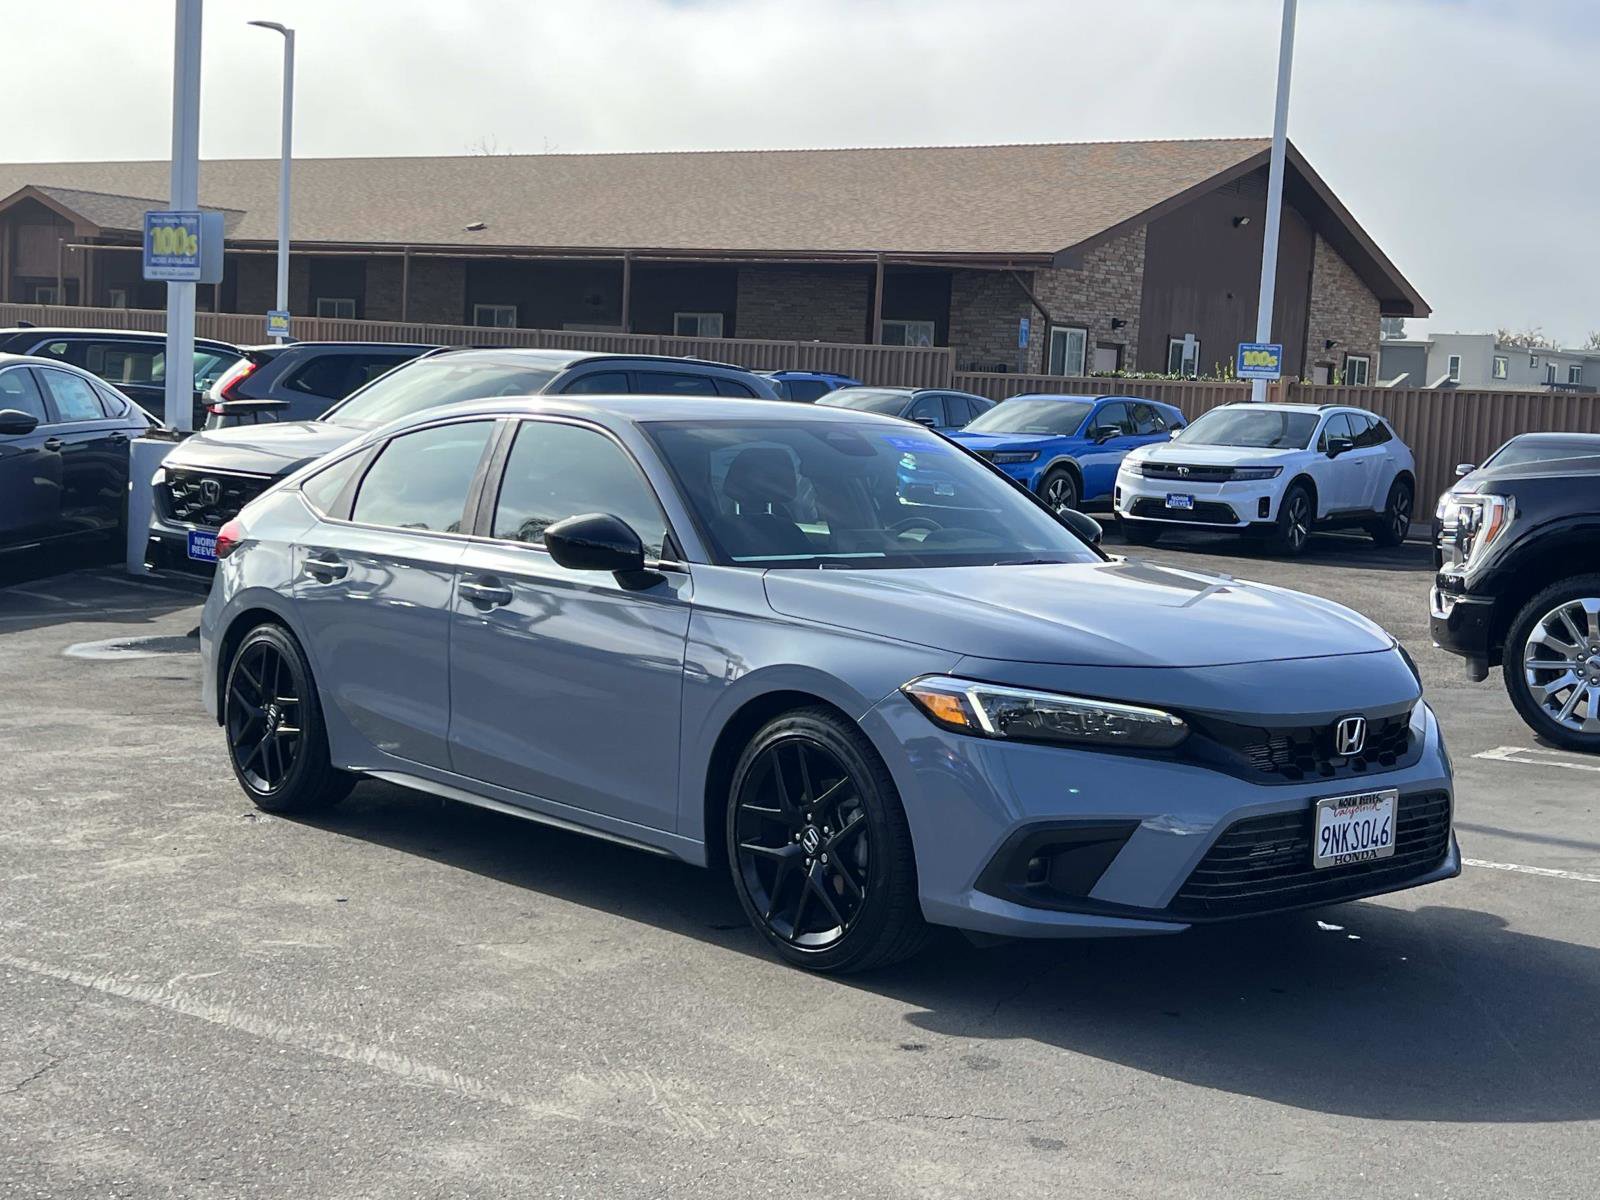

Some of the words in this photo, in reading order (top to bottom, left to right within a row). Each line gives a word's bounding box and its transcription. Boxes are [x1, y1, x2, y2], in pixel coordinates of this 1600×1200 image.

[191, 544, 217, 557] REEVE
[1319, 815, 1391, 857] 9NKS046
[1334, 849, 1378, 865] HONDA
